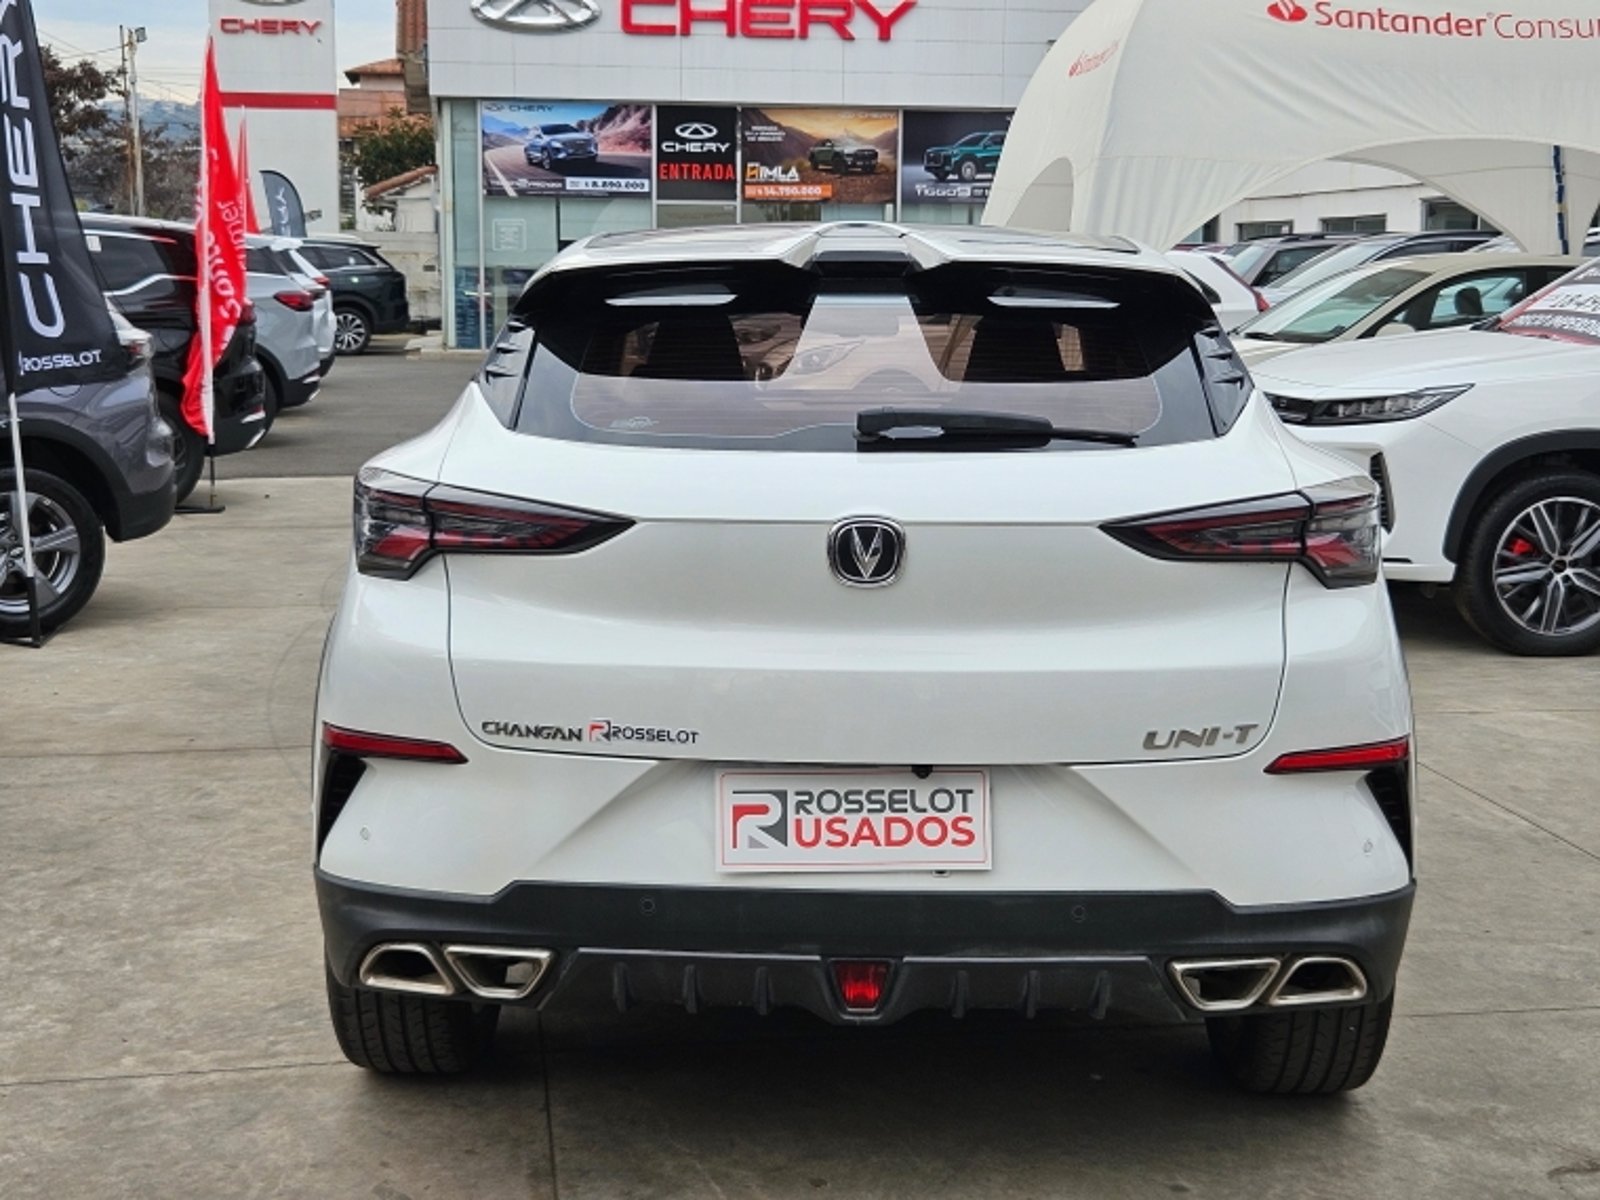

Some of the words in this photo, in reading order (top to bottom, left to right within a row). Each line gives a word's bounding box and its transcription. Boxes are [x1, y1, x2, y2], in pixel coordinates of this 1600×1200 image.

[220, 18, 322, 35] CHERY
[620, 0, 917, 41] CHERY
[1315, 1, 1487, 37] Santander
[1494, 13, 1600, 39] Consu
[661, 142, 731, 153] CHERY
[659, 163, 736, 180] ENTRADA
[482, 720, 583, 742] CHANGAN
[611, 725, 699, 744] ROSSELOT
[1142, 723, 1259, 750] UNI-T
[794, 788, 975, 815] ROSSELOT
[794, 816, 976, 849] USADOS
